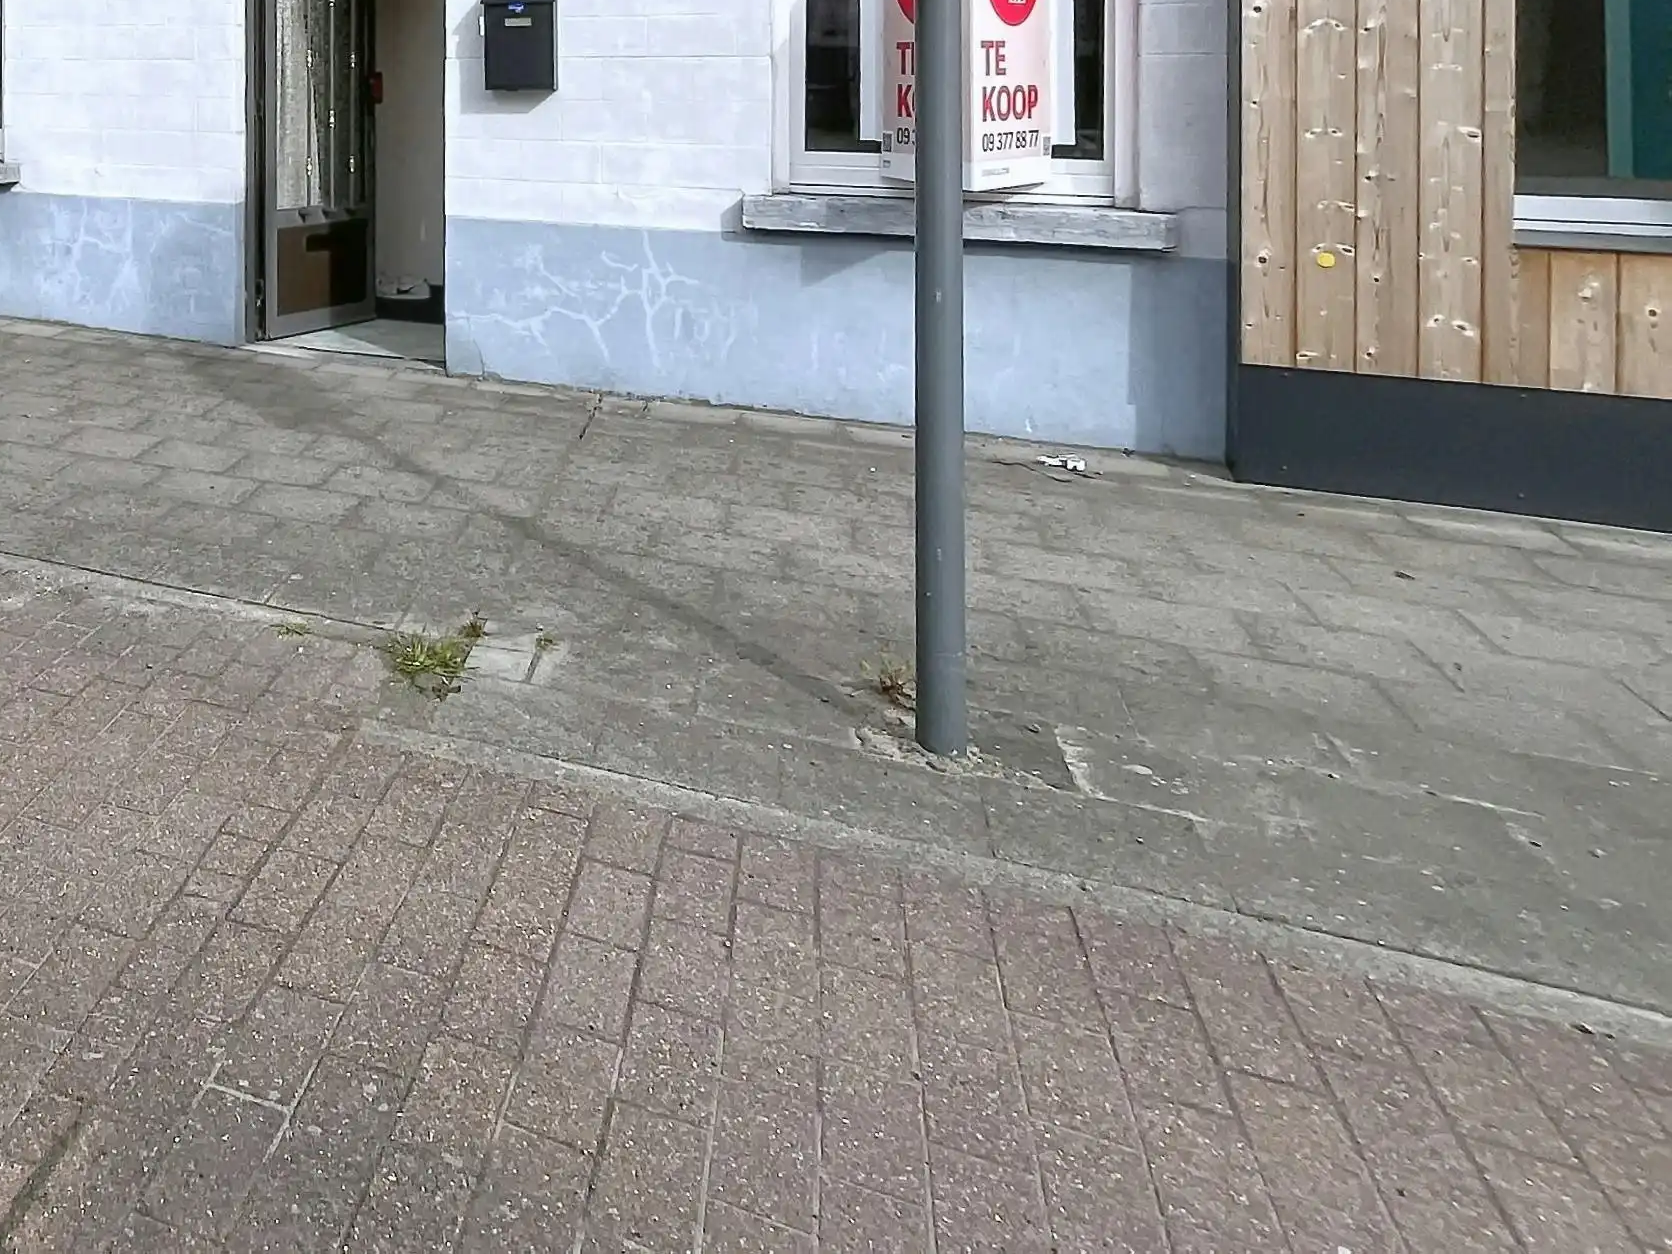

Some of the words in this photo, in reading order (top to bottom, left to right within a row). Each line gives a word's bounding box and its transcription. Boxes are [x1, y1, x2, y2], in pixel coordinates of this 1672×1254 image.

[981, 40, 1007, 76] TE
[982, 84, 1039, 122] KOOP
[896, 127, 910, 145] 09
[982, 133, 995, 152] 09
[996, 131, 1014, 151] 377
[1028, 129, 1040, 147] 77
